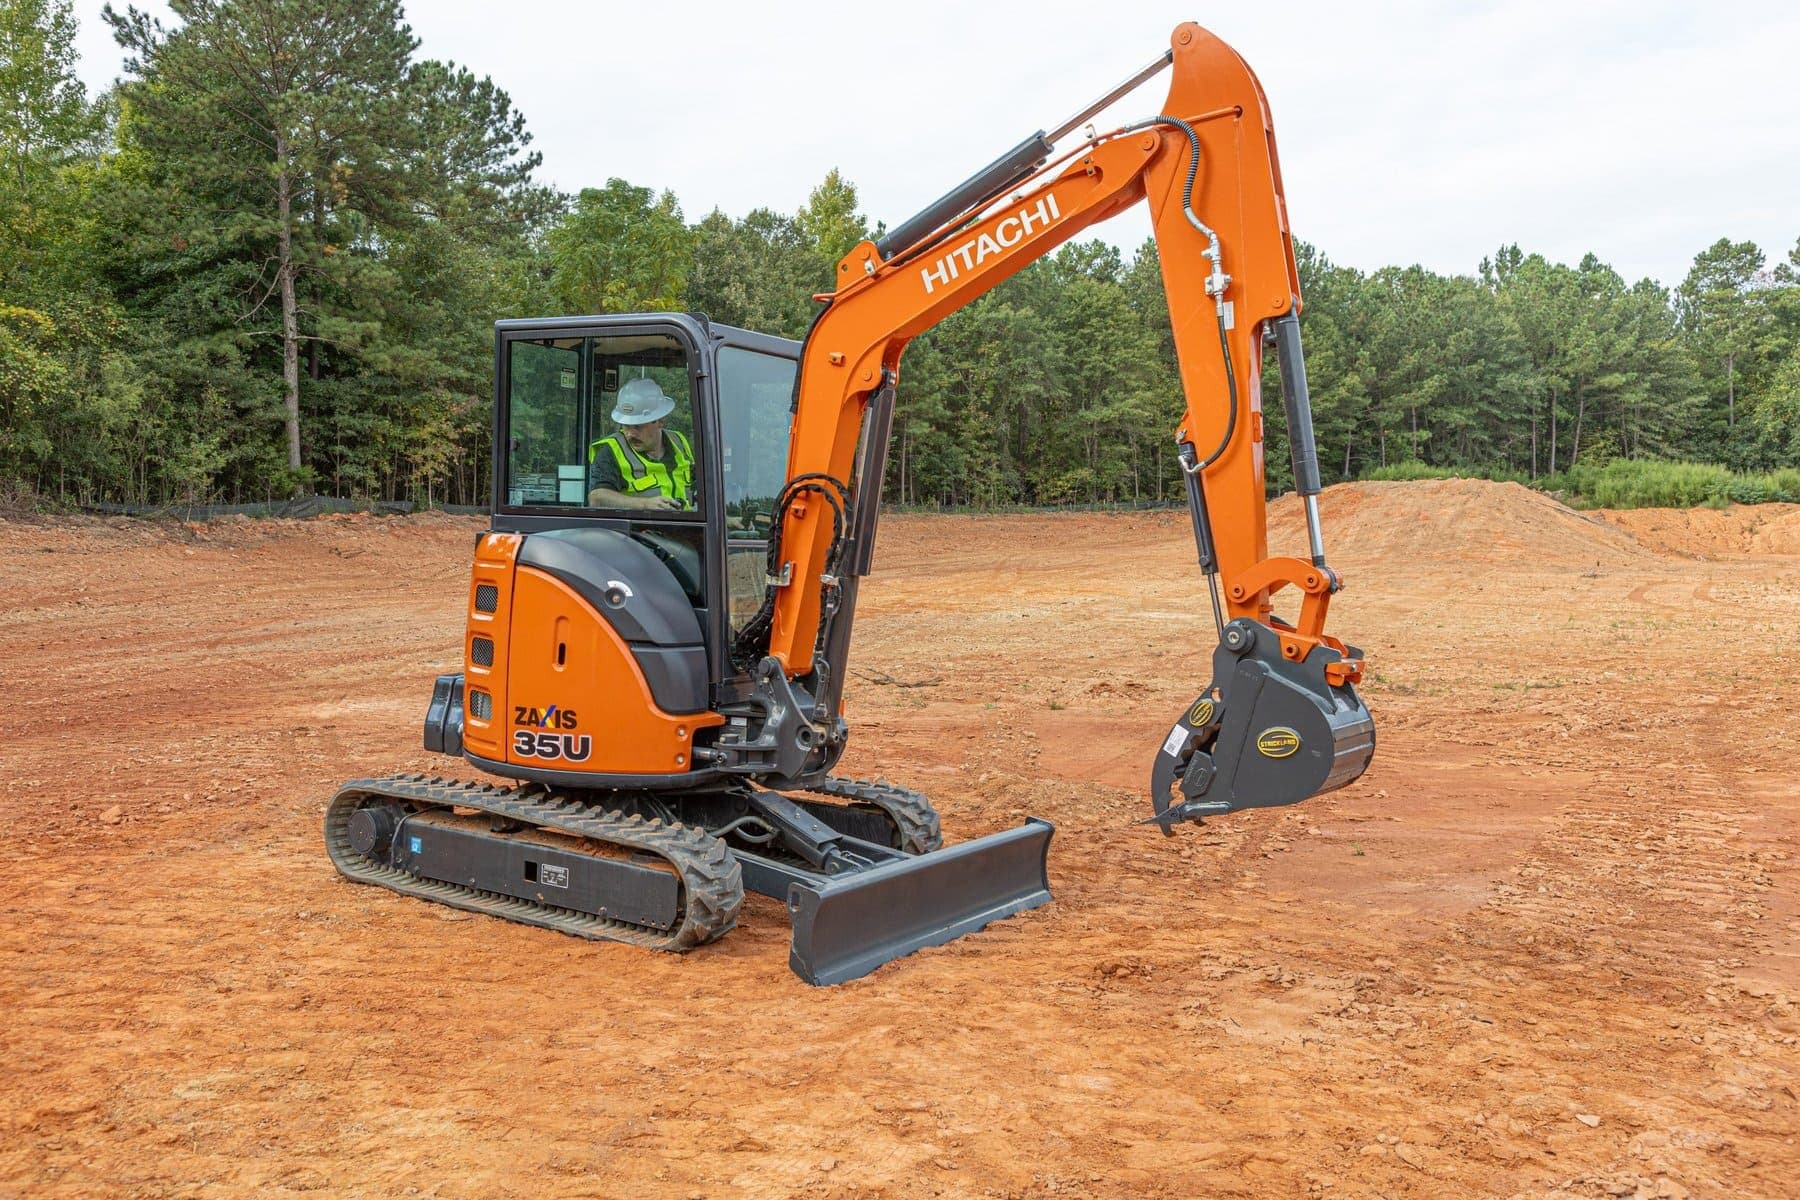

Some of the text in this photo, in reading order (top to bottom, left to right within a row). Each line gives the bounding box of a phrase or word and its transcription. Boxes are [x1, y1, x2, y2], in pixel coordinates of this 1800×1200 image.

[921, 193, 1060, 294] HITACHI
[515, 705, 577, 729] ZAXIS
[513, 730, 592, 762] 35U
